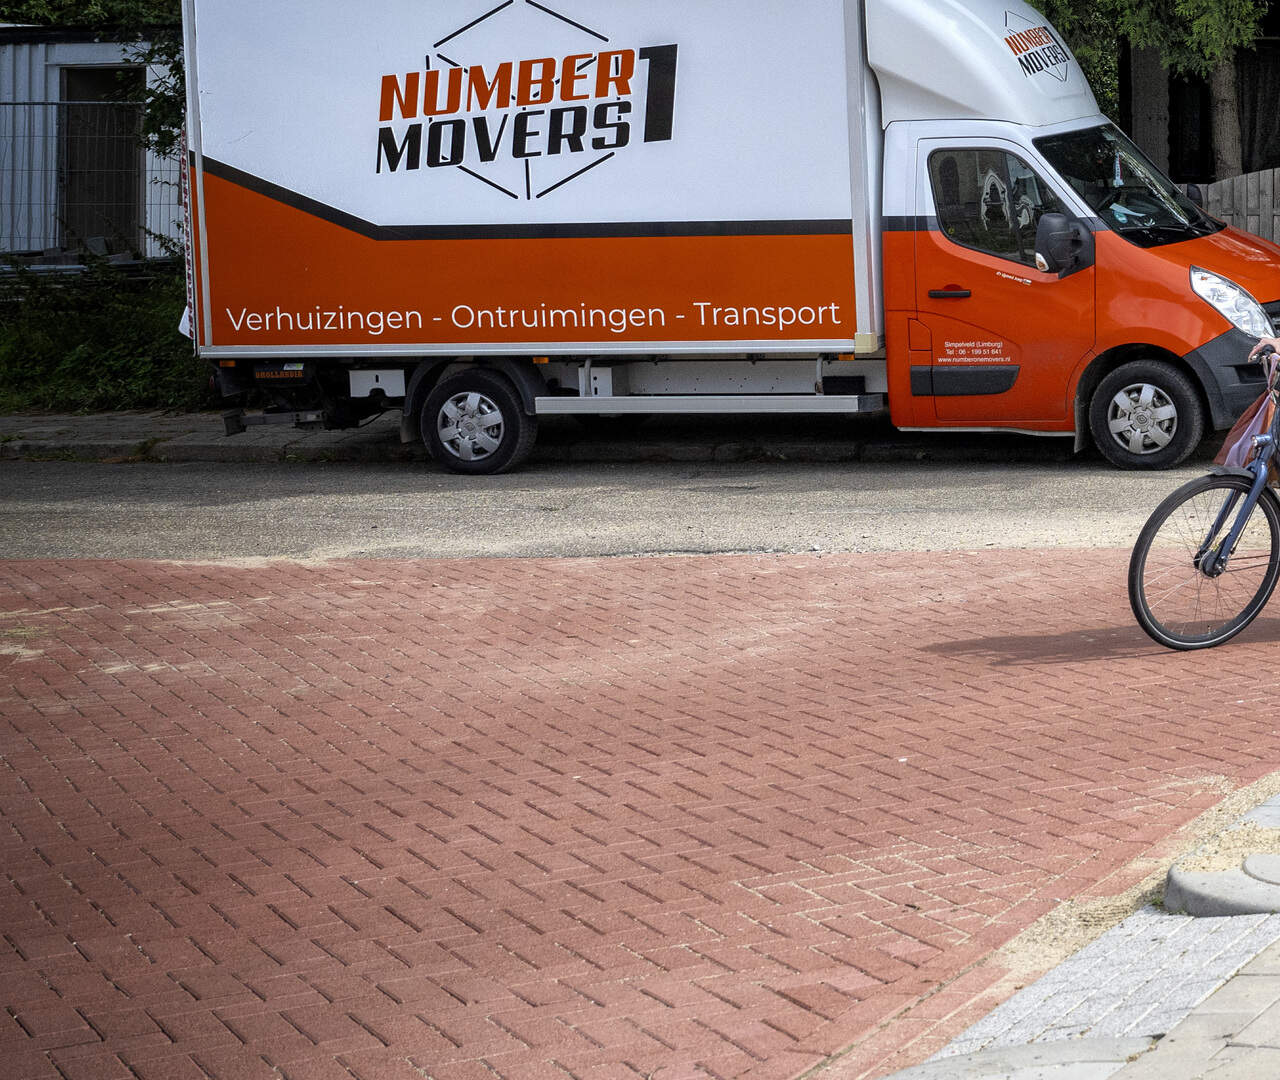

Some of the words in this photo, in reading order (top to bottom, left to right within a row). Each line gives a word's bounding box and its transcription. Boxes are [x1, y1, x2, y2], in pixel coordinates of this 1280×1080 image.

[1004, 27, 1053, 56] NUMBER
[1017, 44, 1067, 78] MOVERS
[378, 48, 635, 122] NUMBER
[638, 43, 678, 143] 1
[376, 100, 632, 174] MOVERS
[226, 305, 422, 335] Verhuizingen
[451, 302, 666, 333] Ontruimingen
[693, 301, 841, 331] Transport
[976, 341, 1003, 349] (Limburg)
